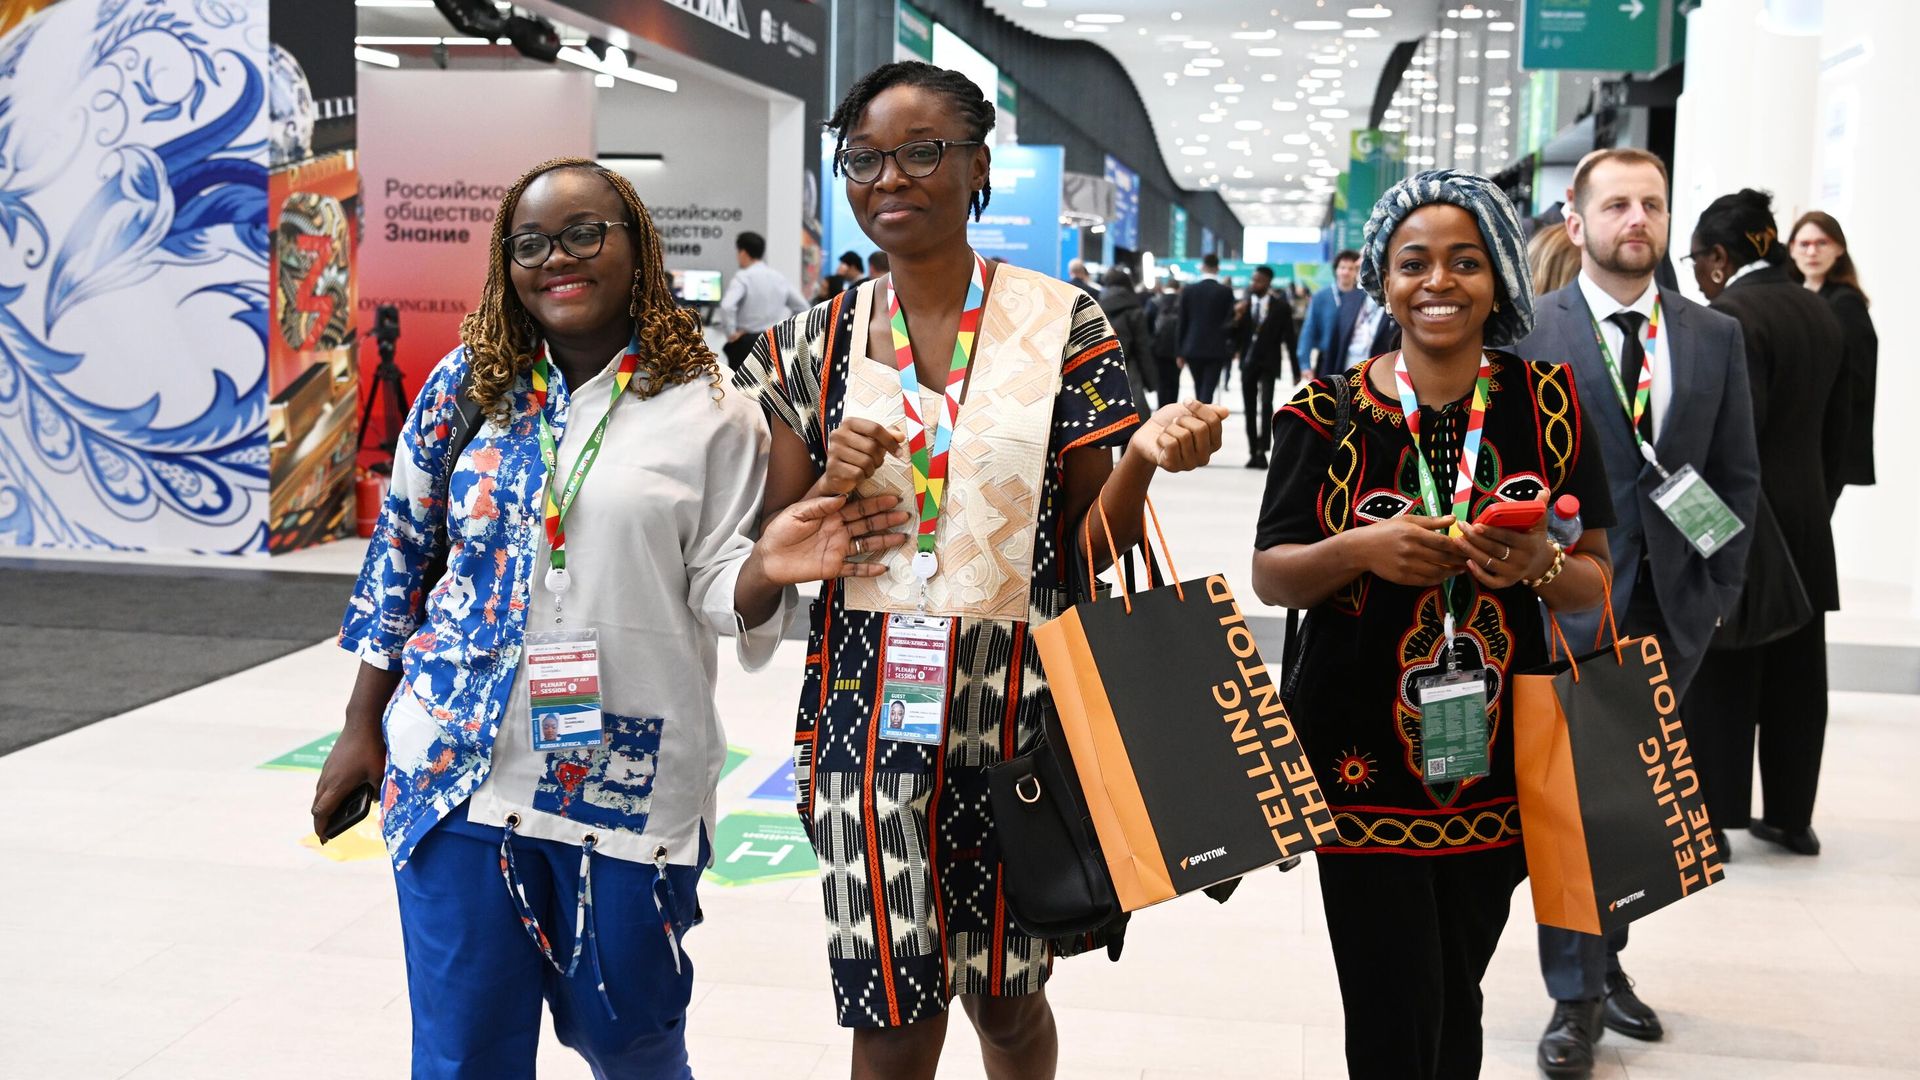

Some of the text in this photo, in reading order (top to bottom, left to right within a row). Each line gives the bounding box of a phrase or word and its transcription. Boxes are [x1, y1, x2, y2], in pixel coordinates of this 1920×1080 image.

[385, 179, 505, 201] Российско
[385, 203, 495, 223] общество
[385, 224, 471, 243] Знание
[895, 666, 918, 674] PLENARY
[895, 672, 917, 680] SESSION
[1208, 575, 1340, 846] THE UNTOLD
[1212, 681, 1302, 856] TELLING
[1640, 635, 1725, 886] THE UNTOLD
[1638, 736, 1701, 897] TELLING
[725, 841, 795, 866] H
[1189, 846, 1228, 866] SPUTNIK
[1616, 889, 1646, 907] SPUTNIK
